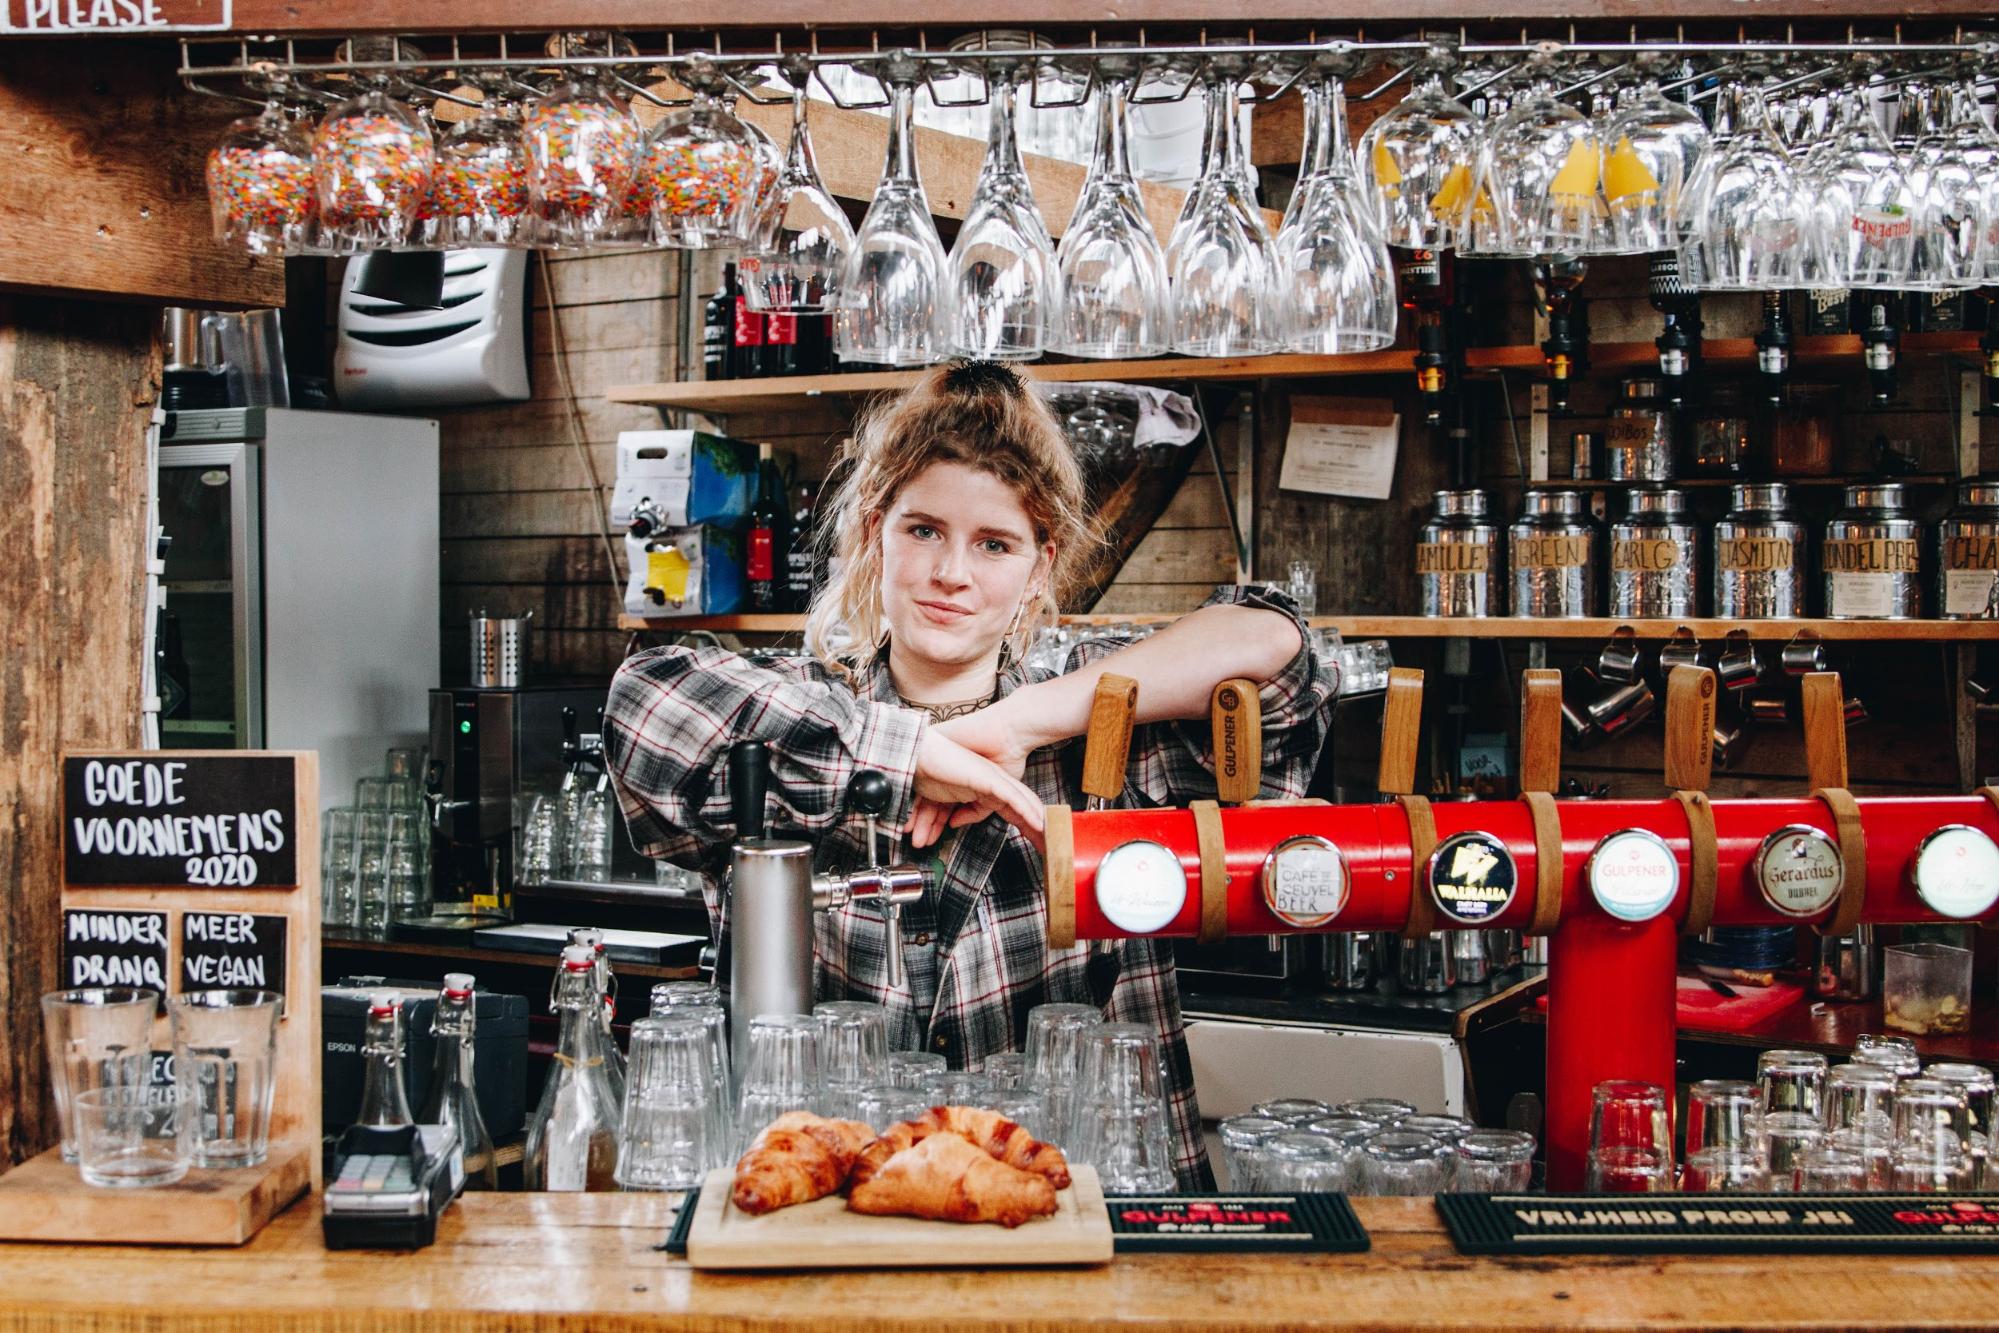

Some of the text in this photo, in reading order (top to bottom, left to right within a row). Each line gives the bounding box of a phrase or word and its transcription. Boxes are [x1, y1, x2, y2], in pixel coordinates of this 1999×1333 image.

[26, 0, 168, 28] PLEASE
[1517, 540, 1579, 567] GREEN
[1225, 715, 1236, 777] GULPENER
[85, 760, 187, 806] GOEDE
[73, 809, 285, 856] VOORNEMENS
[185, 854, 258, 886] 2020
[1602, 863, 1667, 877] GULPENER
[1769, 855, 1834, 888] Gerardus
[68, 913, 168, 948] MINDER
[185, 914, 258, 944] MEER
[185, 954, 266, 986] VEGAN
[327, 1042, 356, 1052] EPSON
[1515, 1209, 1677, 1226] VRIJHEID
[1681, 1210, 1791, 1226] PROEF
